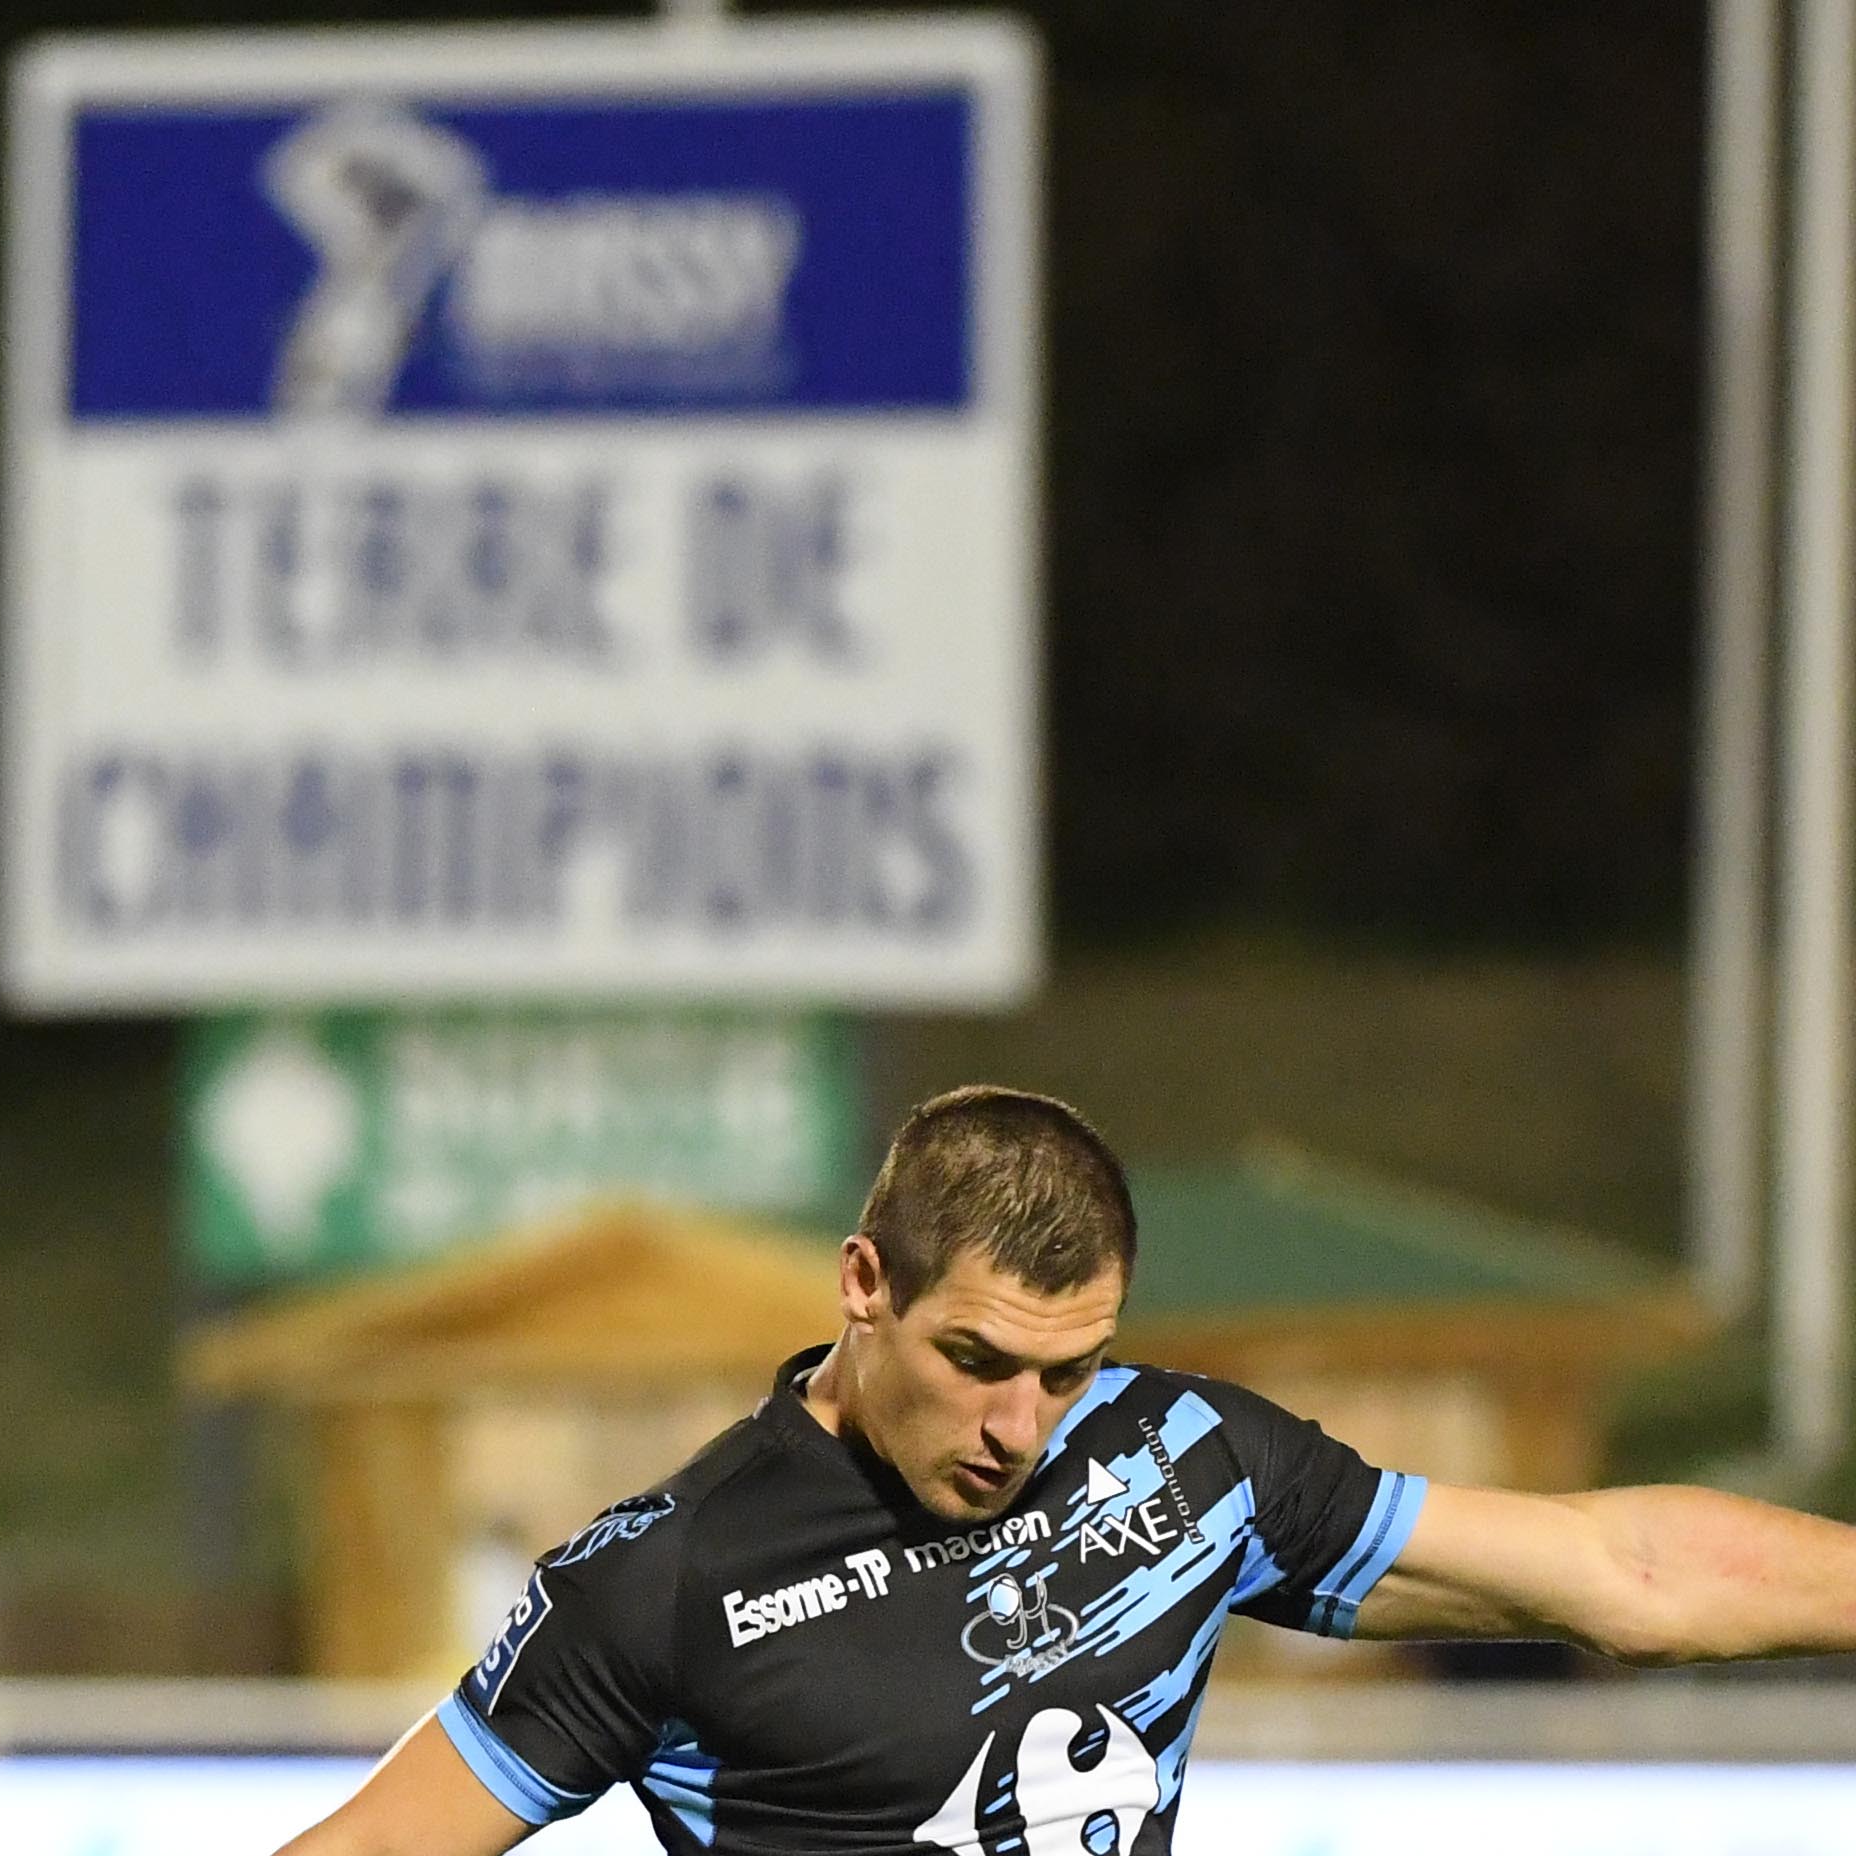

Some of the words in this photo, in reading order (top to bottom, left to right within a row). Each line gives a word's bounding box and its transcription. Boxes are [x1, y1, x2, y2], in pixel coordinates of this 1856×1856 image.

[166, 478, 624, 668] TERRE
[682, 474, 866, 668] DE
[58, 746, 976, 932] CHAMPIONS
[904, 1510, 1052, 1573] macron
[1080, 1498, 1178, 1563] AXE
[1138, 1417, 1205, 1543] promotion
